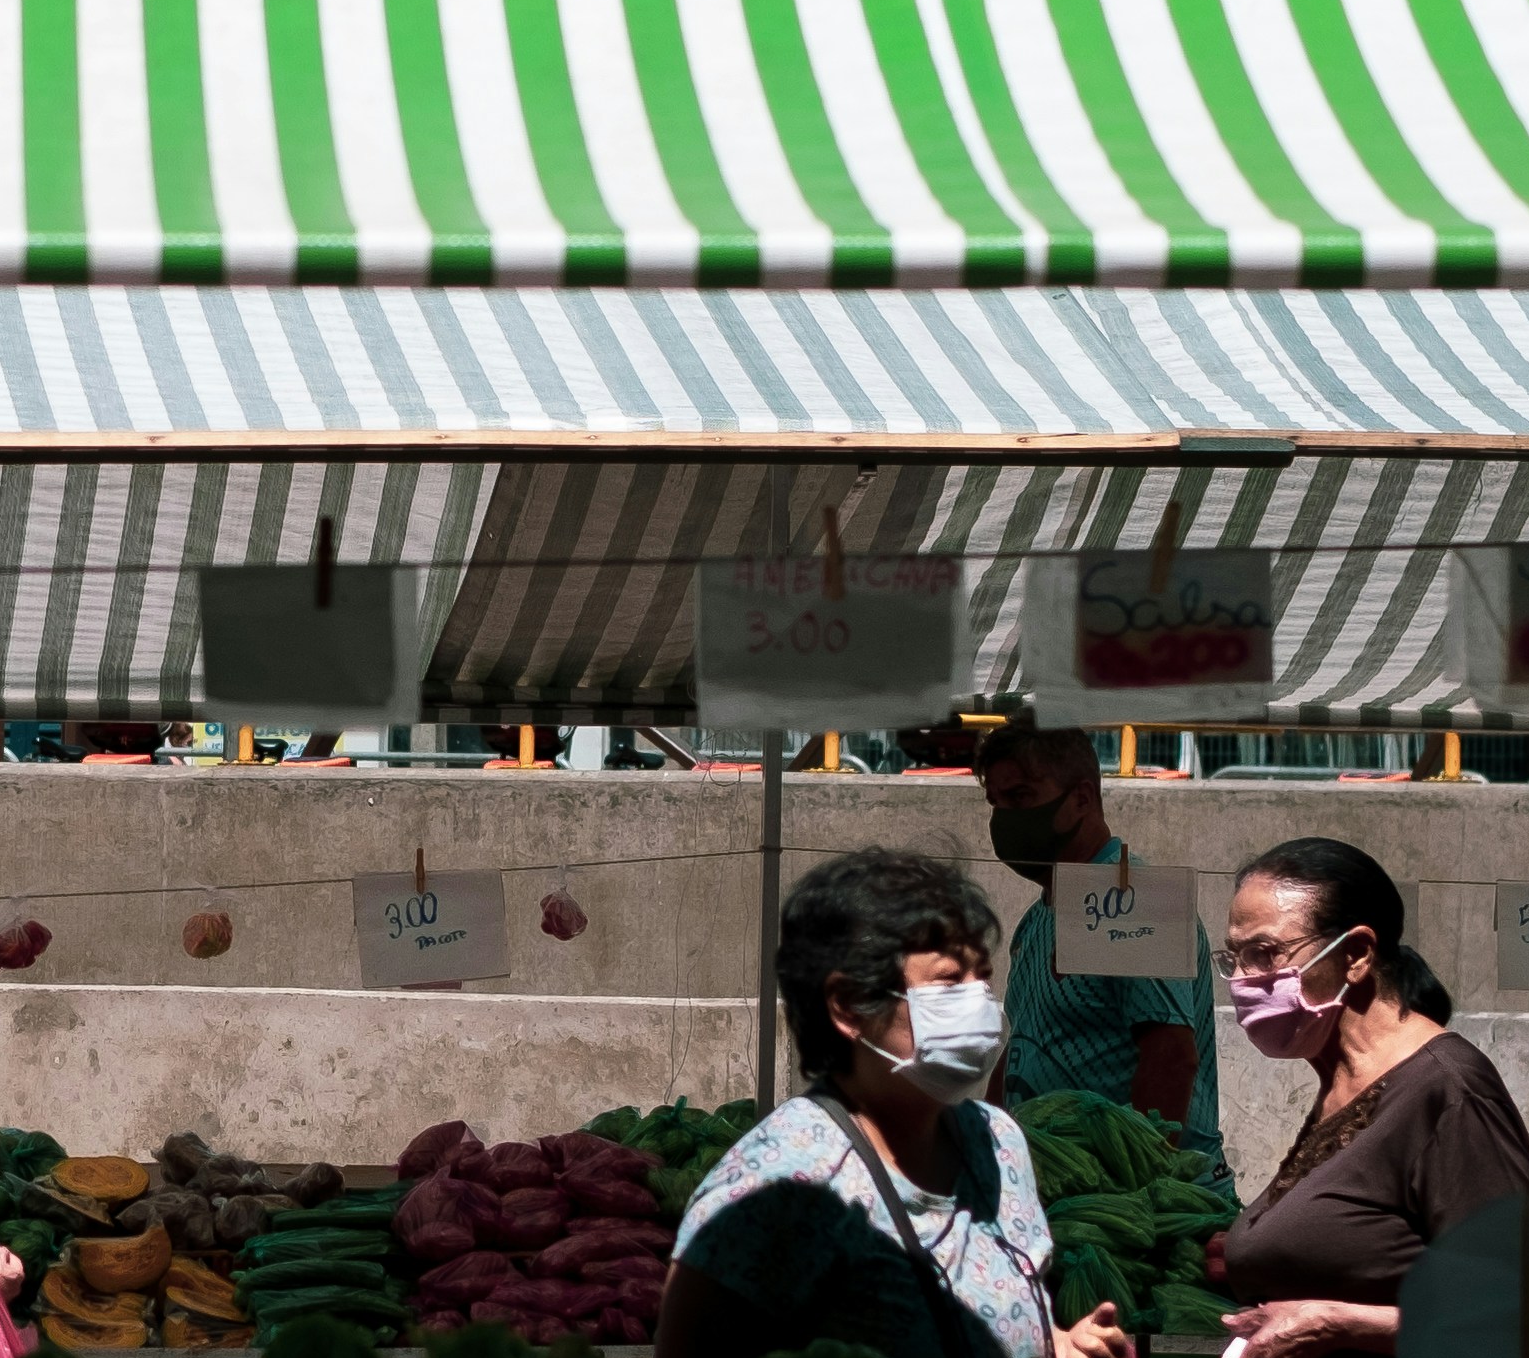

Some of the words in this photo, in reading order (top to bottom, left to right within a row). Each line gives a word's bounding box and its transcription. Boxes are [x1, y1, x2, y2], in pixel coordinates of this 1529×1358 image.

[1080, 559, 1273, 638] Salsa
[745, 610, 851, 656] 3.00
[384, 891, 438, 940] 3.00
